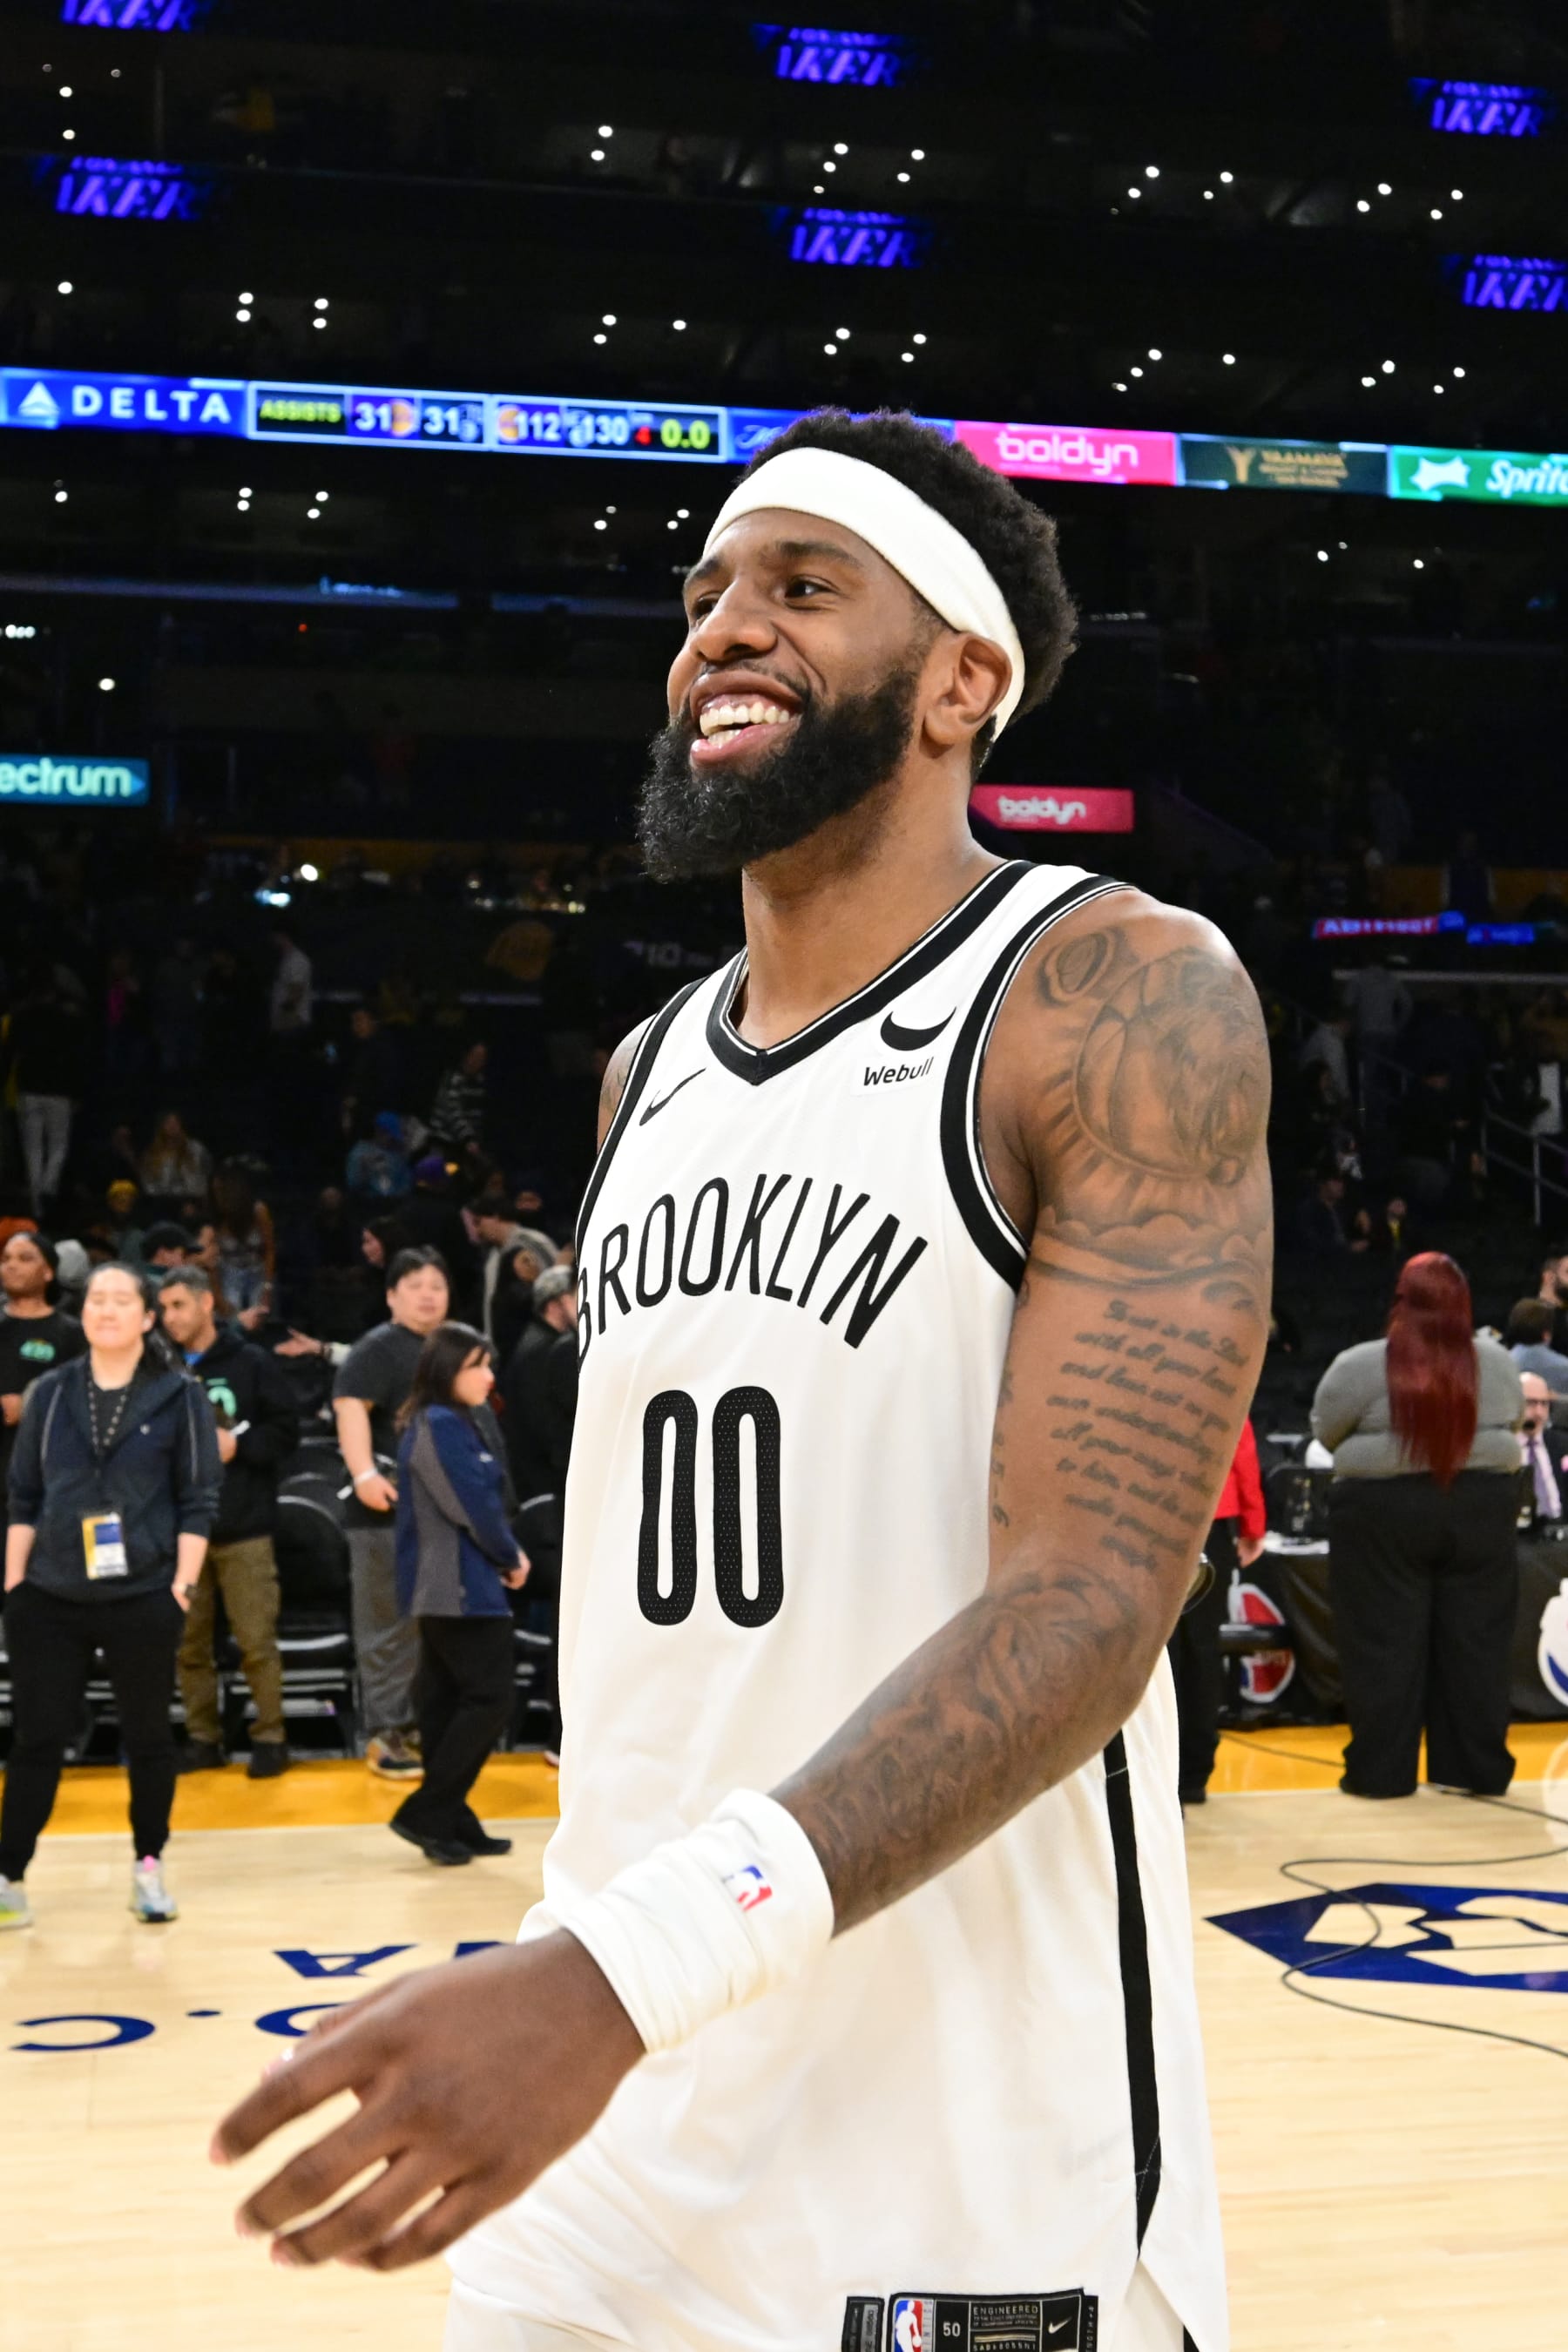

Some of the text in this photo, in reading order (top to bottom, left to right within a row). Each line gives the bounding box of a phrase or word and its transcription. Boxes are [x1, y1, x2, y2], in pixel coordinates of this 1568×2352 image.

[71, 385, 231, 423] DELTA
[260, 399, 459, 435] ASSISTS 31 31
[515, 409, 561, 442] 112
[583, 413, 630, 445] 130
[660, 418, 711, 449] 0.0
[995, 431, 1139, 476] boldyn
[997, 795, 1087, 825] boldyn
[863, 1057, 934, 1086] Webull
[577, 1173, 929, 1374] BROOKLYN
[638, 1386, 784, 1628] 00
[973, 2304, 1038, 2315] ENGINEERED
[943, 2322, 961, 2337] 50
